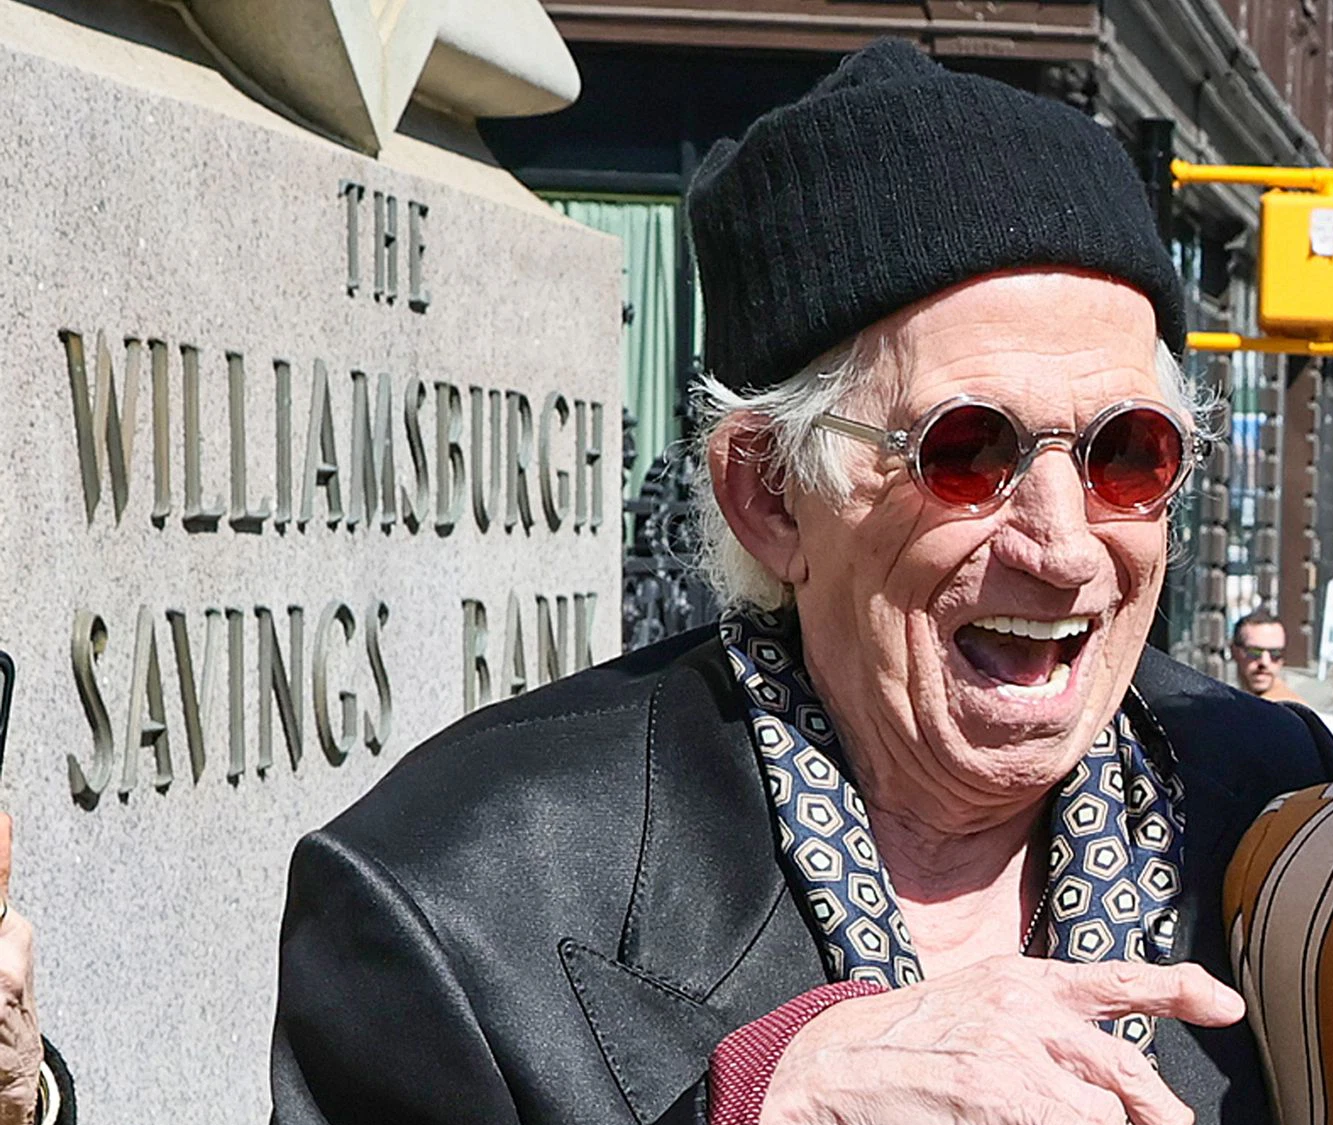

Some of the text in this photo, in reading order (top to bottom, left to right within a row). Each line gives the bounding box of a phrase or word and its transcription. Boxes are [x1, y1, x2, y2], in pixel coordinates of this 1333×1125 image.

[338, 179, 430, 314] THE
[58, 328, 604, 536] WILLIAMSBURGH
[67, 600, 391, 812] SAVINGS
